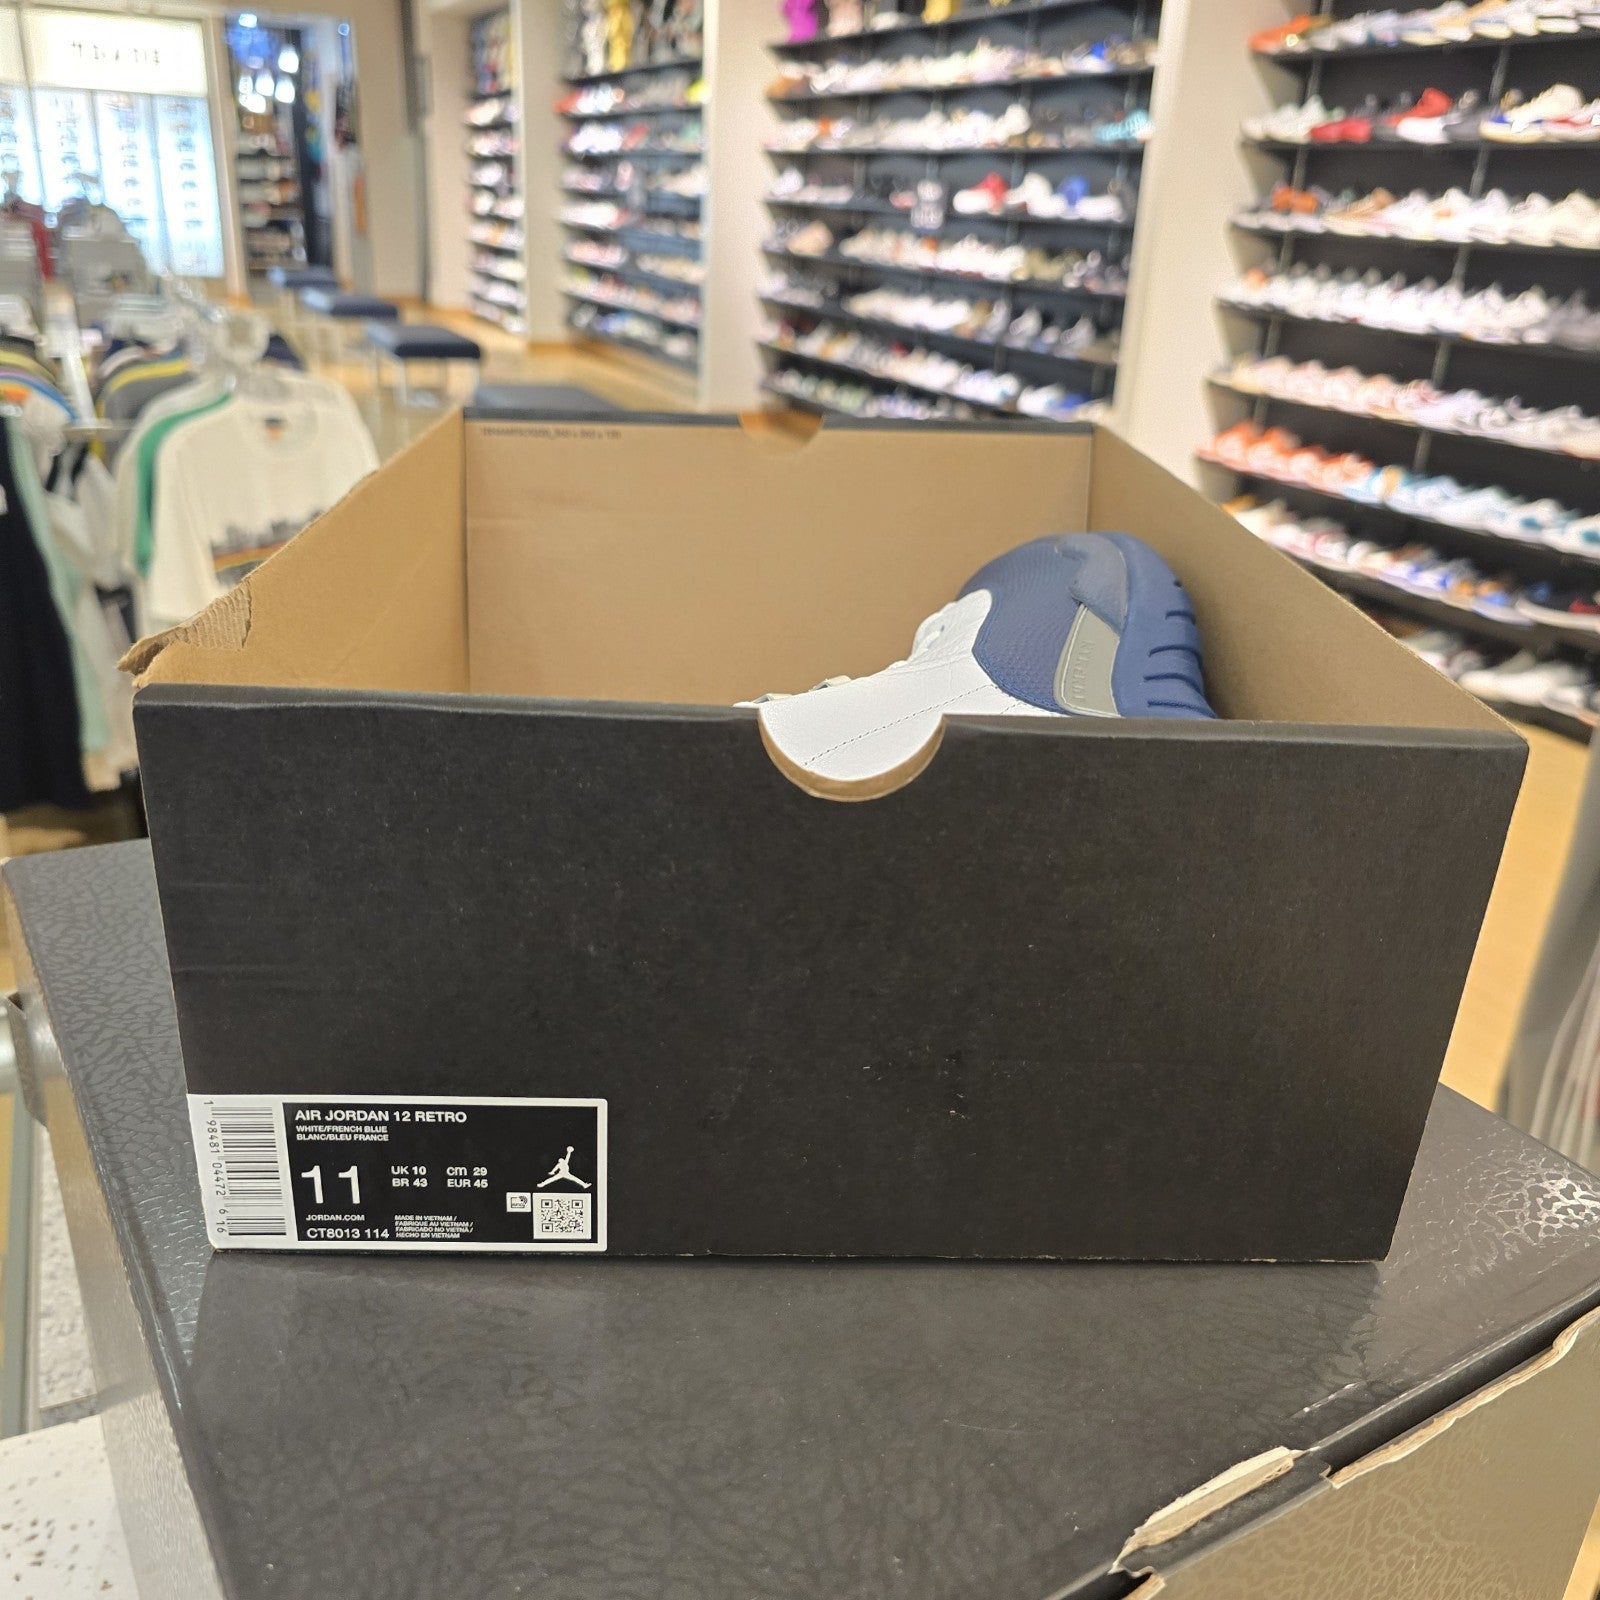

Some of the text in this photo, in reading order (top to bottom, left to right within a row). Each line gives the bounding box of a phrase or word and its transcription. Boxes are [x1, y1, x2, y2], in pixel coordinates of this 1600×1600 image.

[294, 1110, 467, 1123] AIR JORDAN 12 RETRO
[296, 1125, 388, 1133] WHITE/FRENCH BLUE
[206, 1120, 220, 1153] 98481
[296, 1133, 389, 1142] BLANC/BLEU FRANCE
[391, 1166, 427, 1175] UK 10
[473, 1167, 488, 1176] 29
[212, 1163, 226, 1196] 04472
[392, 1178, 428, 1188] BR 43
[447, 1179, 488, 1188] EUR 45
[306, 1214, 365, 1222] JORDAN.COM
[306, 1228, 390, 1239] CT8013 114
